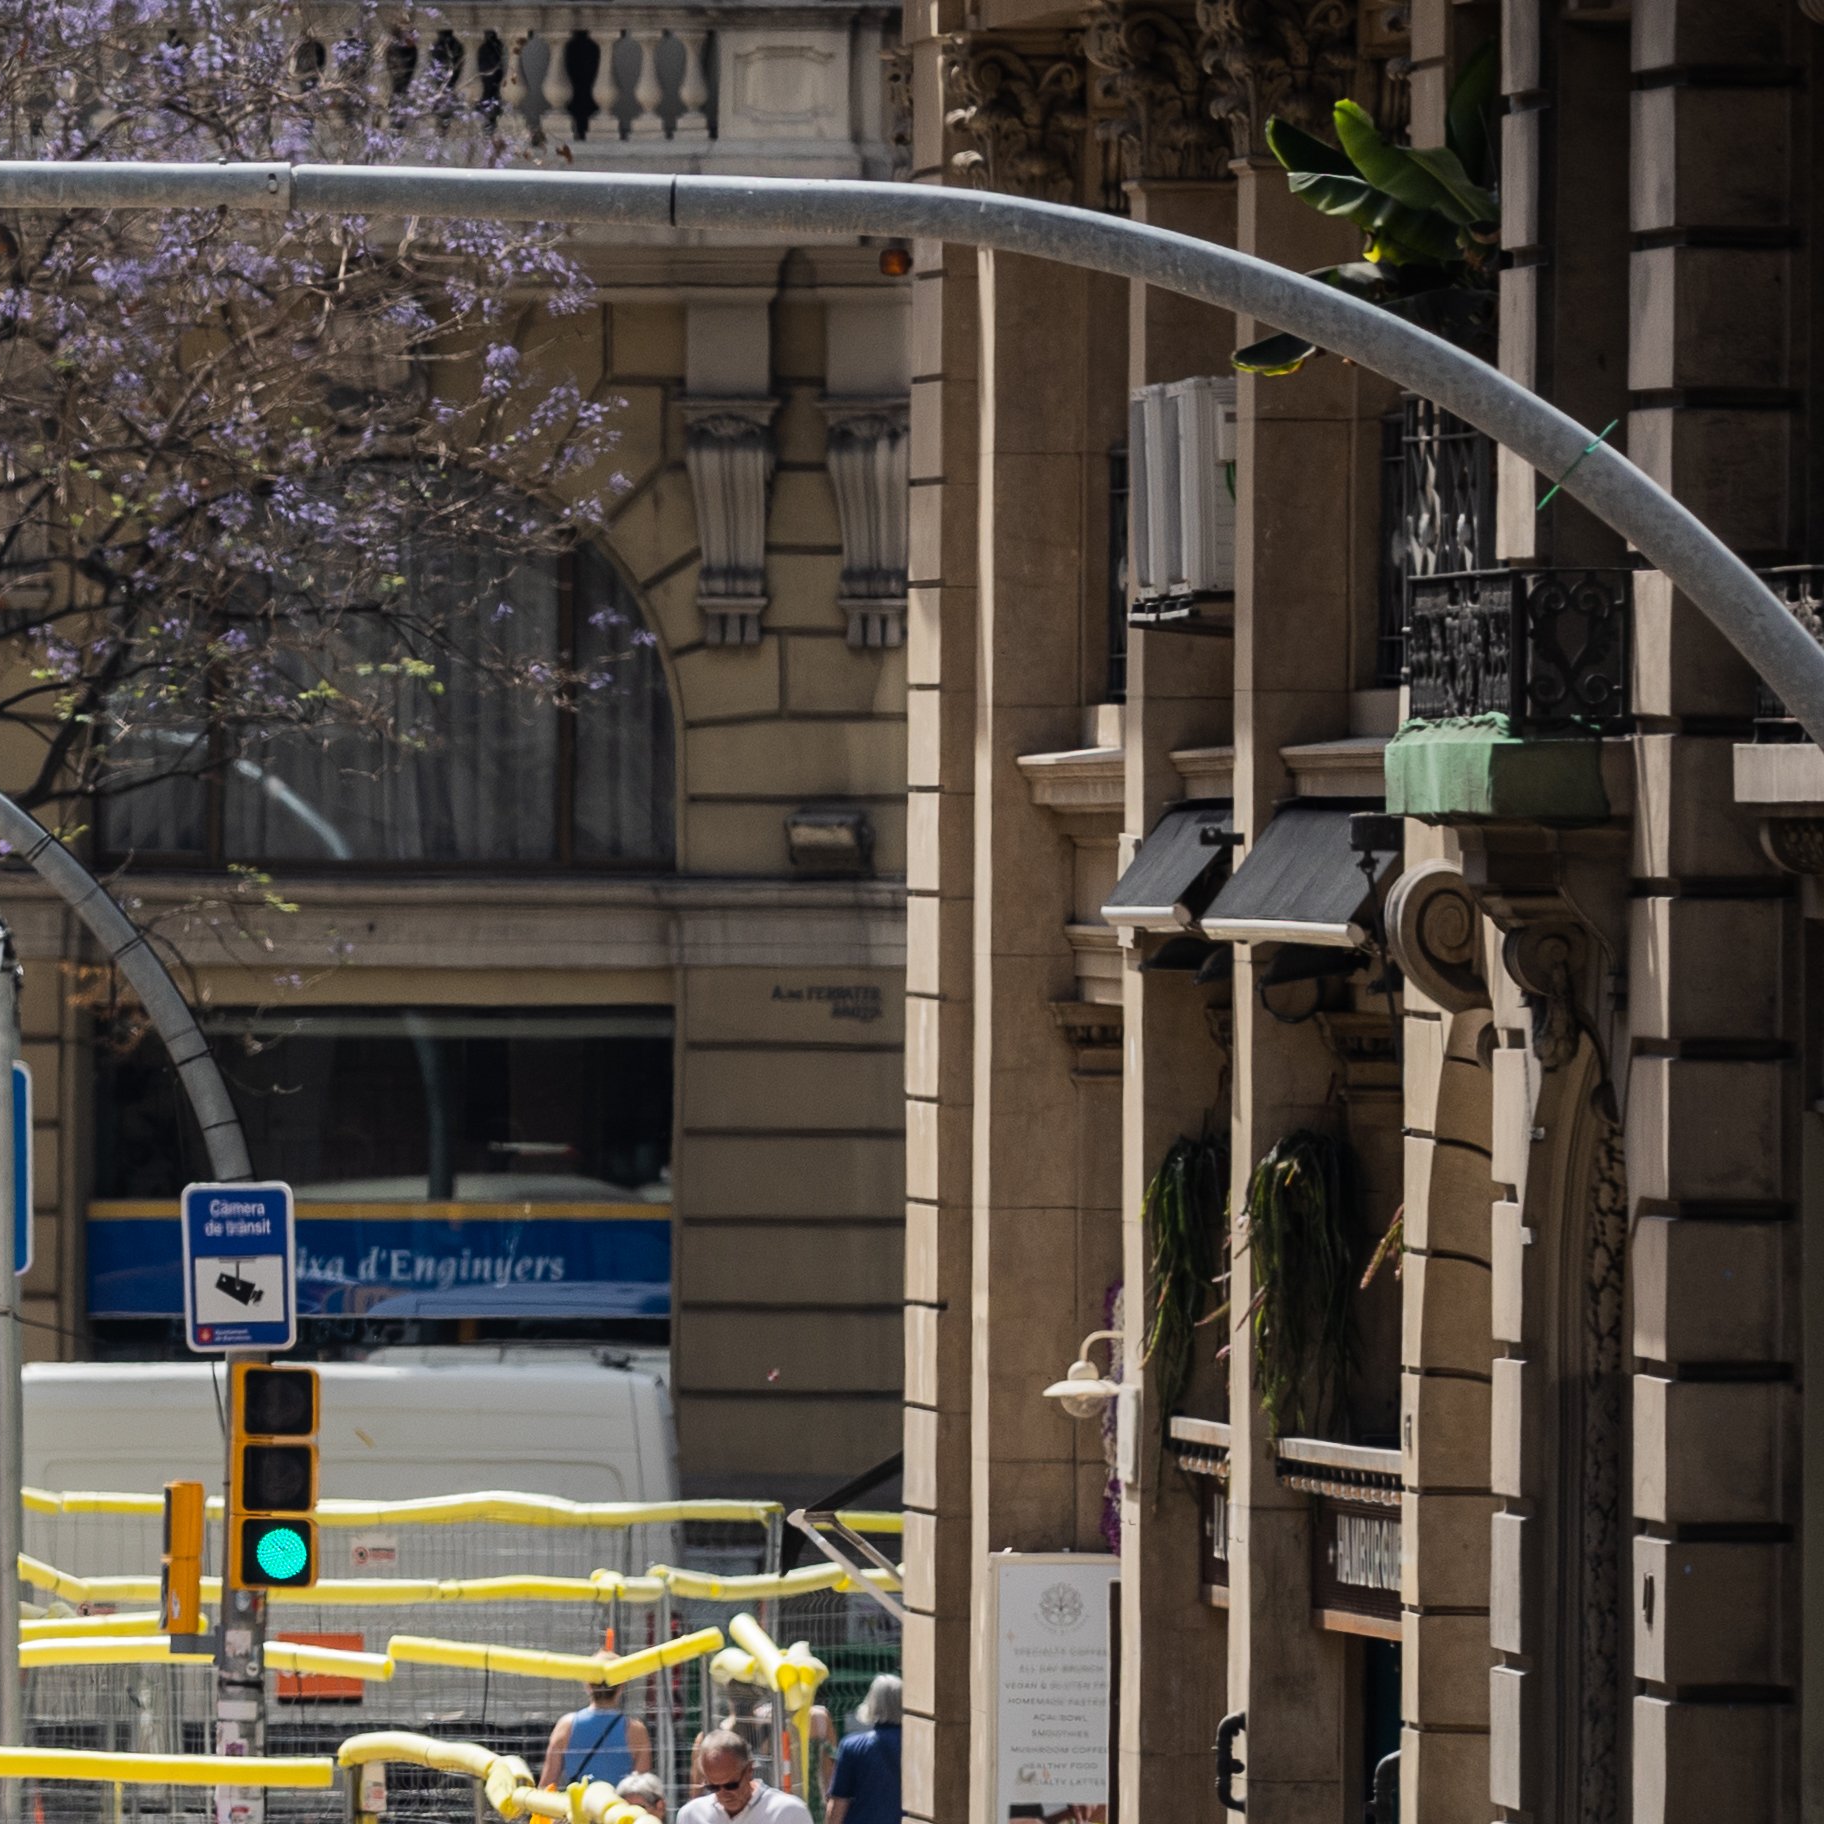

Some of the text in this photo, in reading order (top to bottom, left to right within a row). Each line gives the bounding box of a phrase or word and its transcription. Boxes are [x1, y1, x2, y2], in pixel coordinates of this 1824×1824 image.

[210, 1199, 266, 1218] Càmera
[205, 1220, 223, 1237] de
[358, 1245, 565, 1291] d'Enginyers
